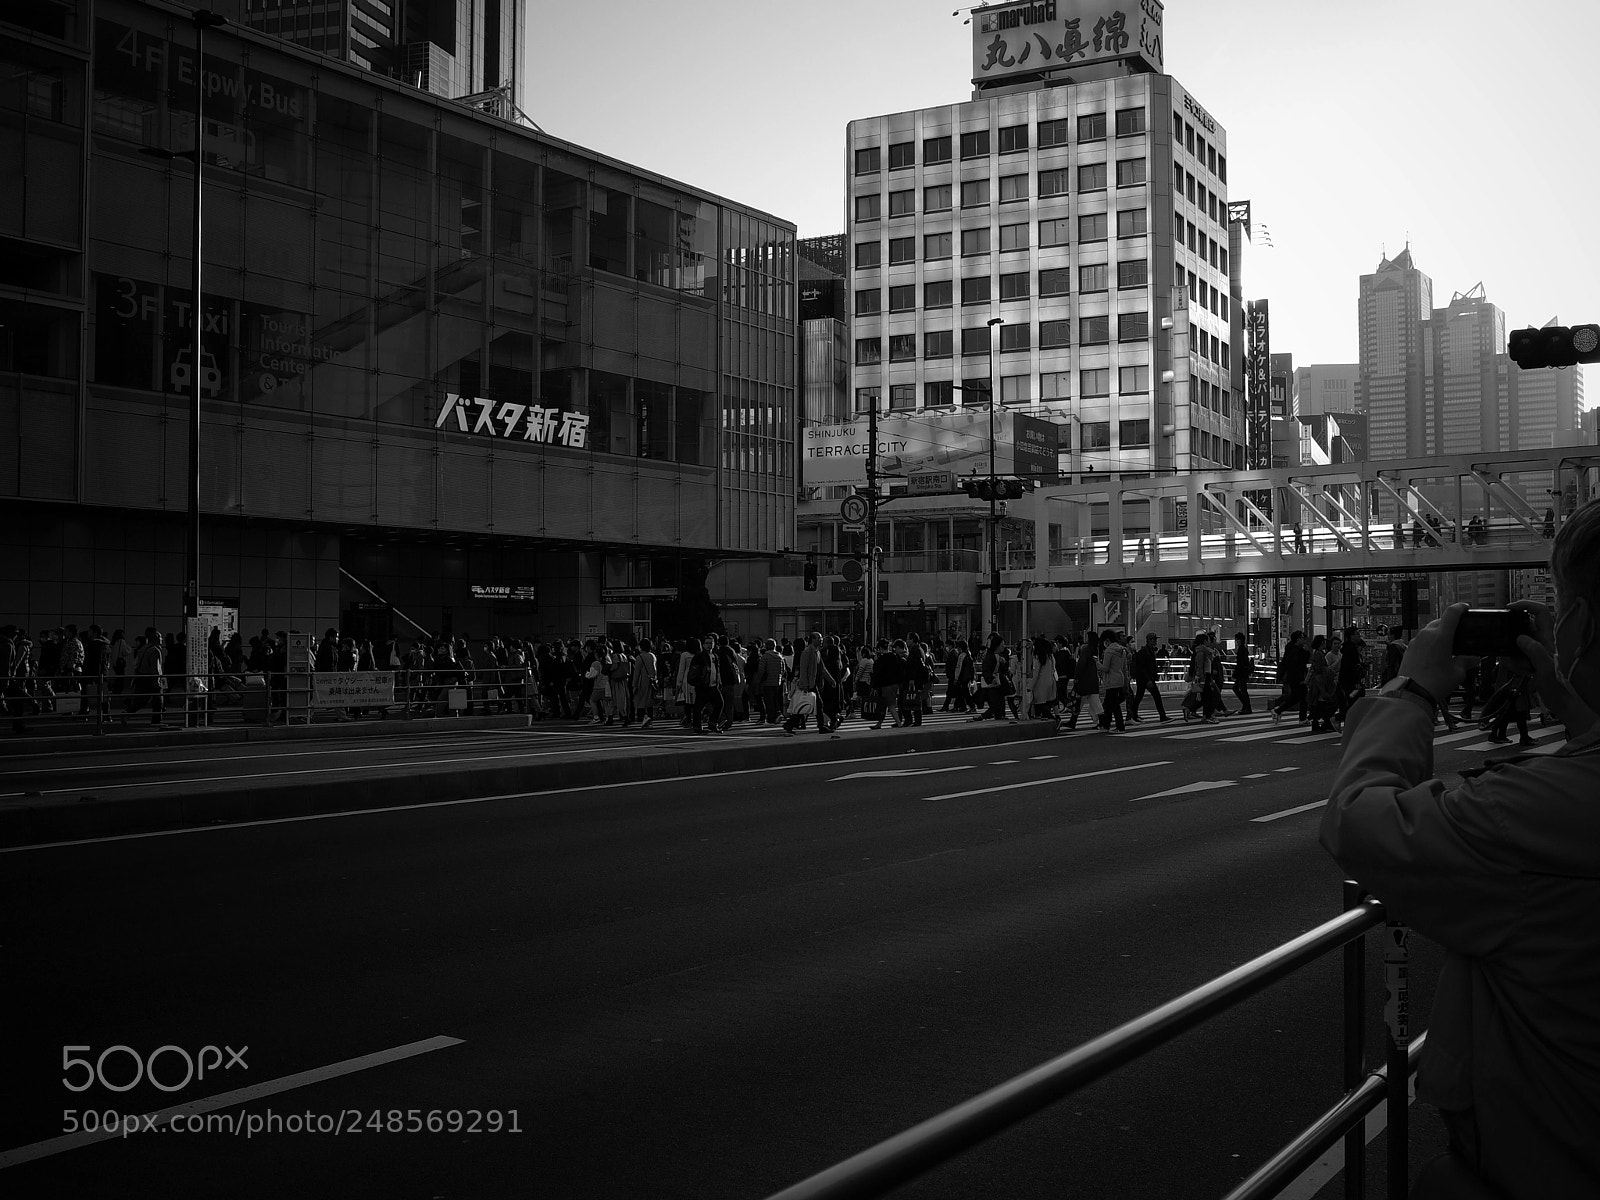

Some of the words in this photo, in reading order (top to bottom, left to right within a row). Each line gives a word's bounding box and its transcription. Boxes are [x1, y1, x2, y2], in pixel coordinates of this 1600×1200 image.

[115, 26, 163, 73] 4F
[260, 81, 303, 117] Bus
[116, 278, 157, 321] 3F
[259, 333, 343, 363] Informatio
[259, 352, 312, 375] Center
[434, 392, 590, 449] バスタ新宿
[808, 428, 856, 439] SHINJUKU
[807, 444, 870, 458] TERRACE
[877, 441, 908, 453] CITY
[910, 474, 948, 485] 新宿駅南口
